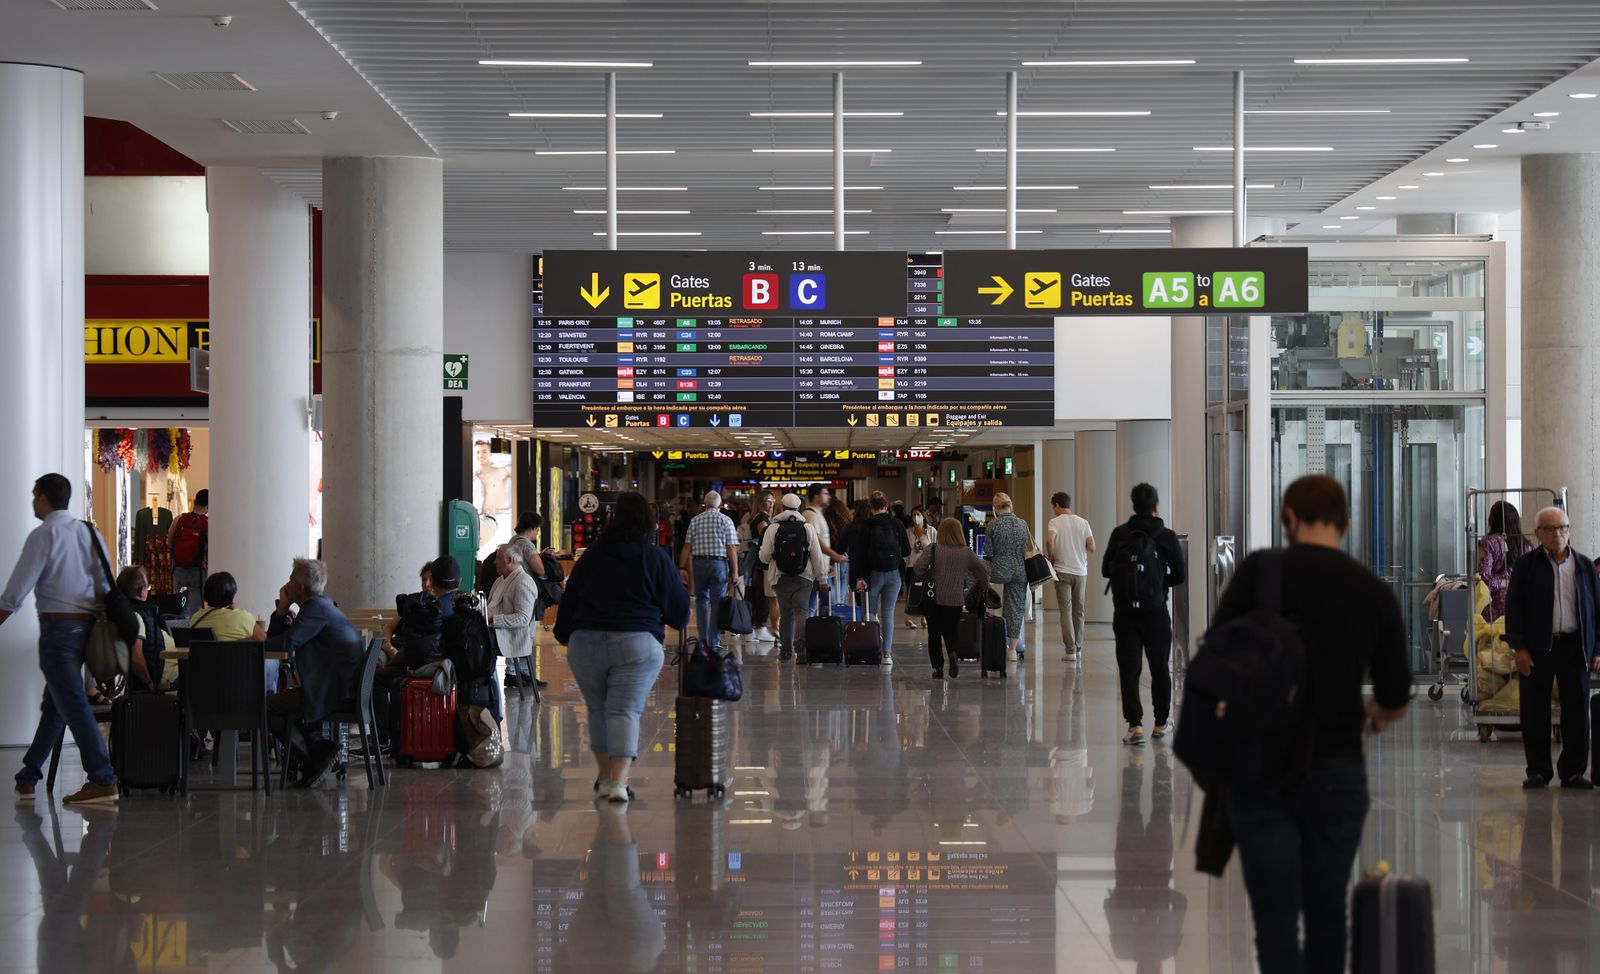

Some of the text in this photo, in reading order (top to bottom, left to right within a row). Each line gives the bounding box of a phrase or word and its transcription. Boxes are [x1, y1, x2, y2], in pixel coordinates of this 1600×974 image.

[749, 262, 755, 270] 3
[793, 262, 804, 270] 13
[671, 275, 709, 288] Gates
[1072, 274, 1110, 286] Gates
[1197, 274, 1210, 286] to
[752, 279, 770, 304] B
[798, 279, 817, 304] C
[1148, 278, 1188, 302] A5
[1219, 277, 1259, 302] A6
[671, 293, 732, 307] Puertas
[1072, 292, 1132, 306] Puertas
[1199, 295, 1208, 306] a
[660, 417, 666, 425] B
[680, 416, 686, 425] C
